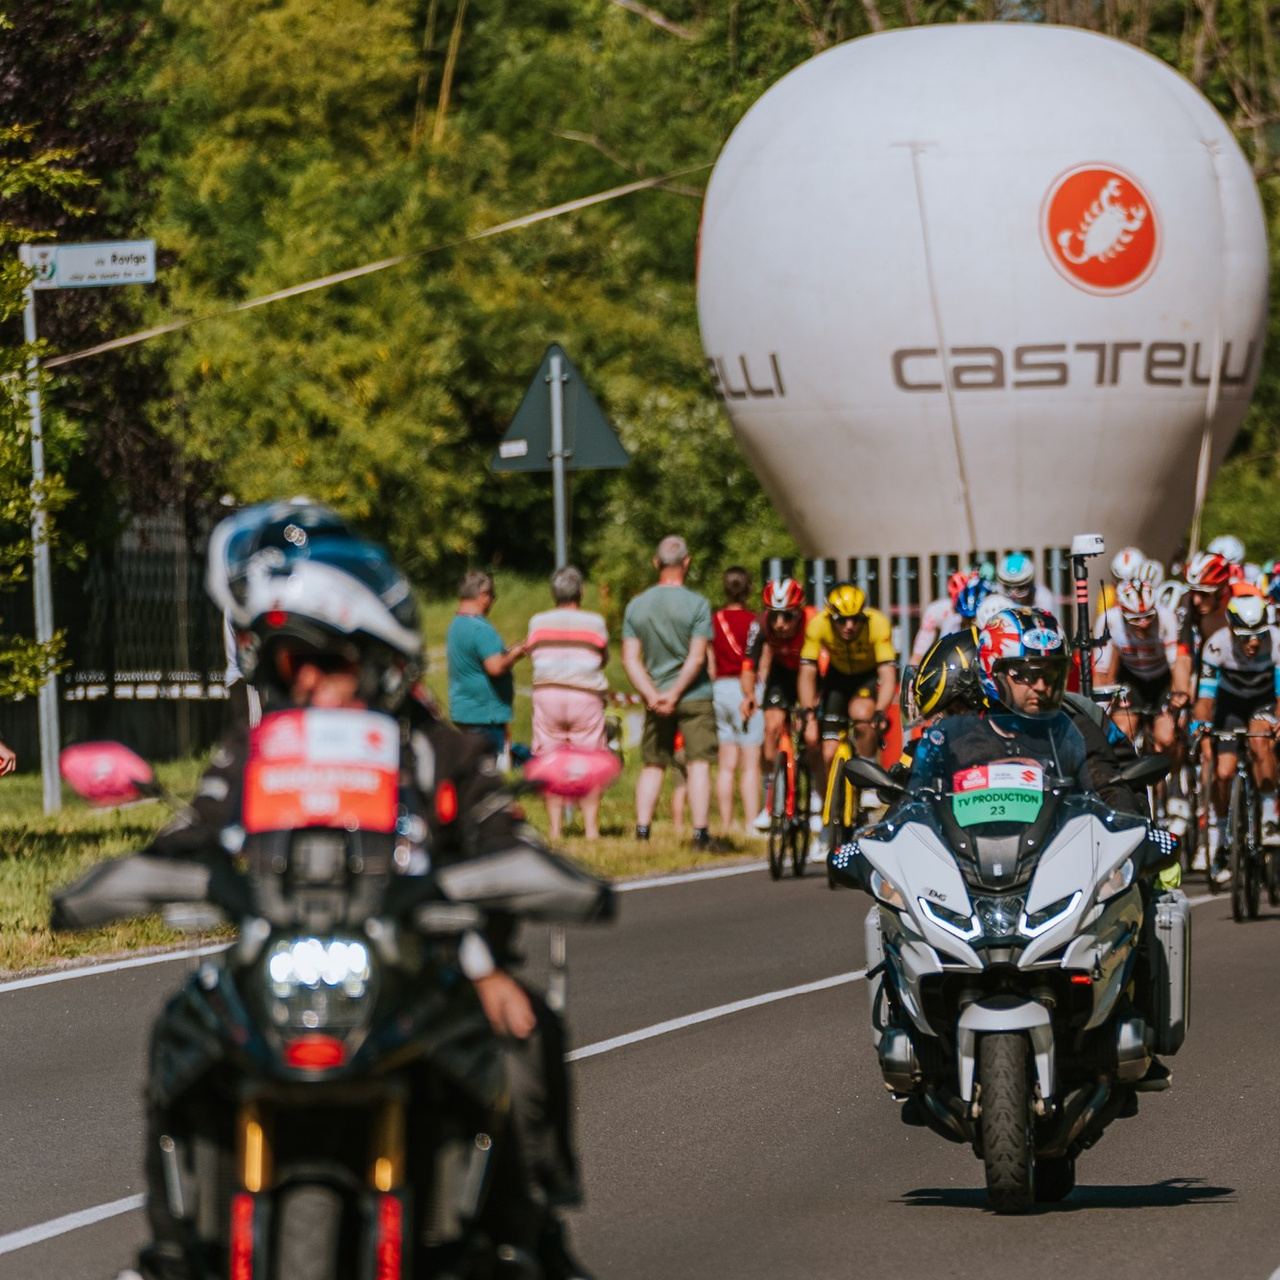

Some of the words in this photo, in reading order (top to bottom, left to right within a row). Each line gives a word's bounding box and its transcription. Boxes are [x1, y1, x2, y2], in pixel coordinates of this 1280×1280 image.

[111, 253, 147, 266] Rovigo
[957, 798, 971, 807] TV
[972, 793, 1039, 804] PRODUCTION
[990, 805, 1006, 816] 23
